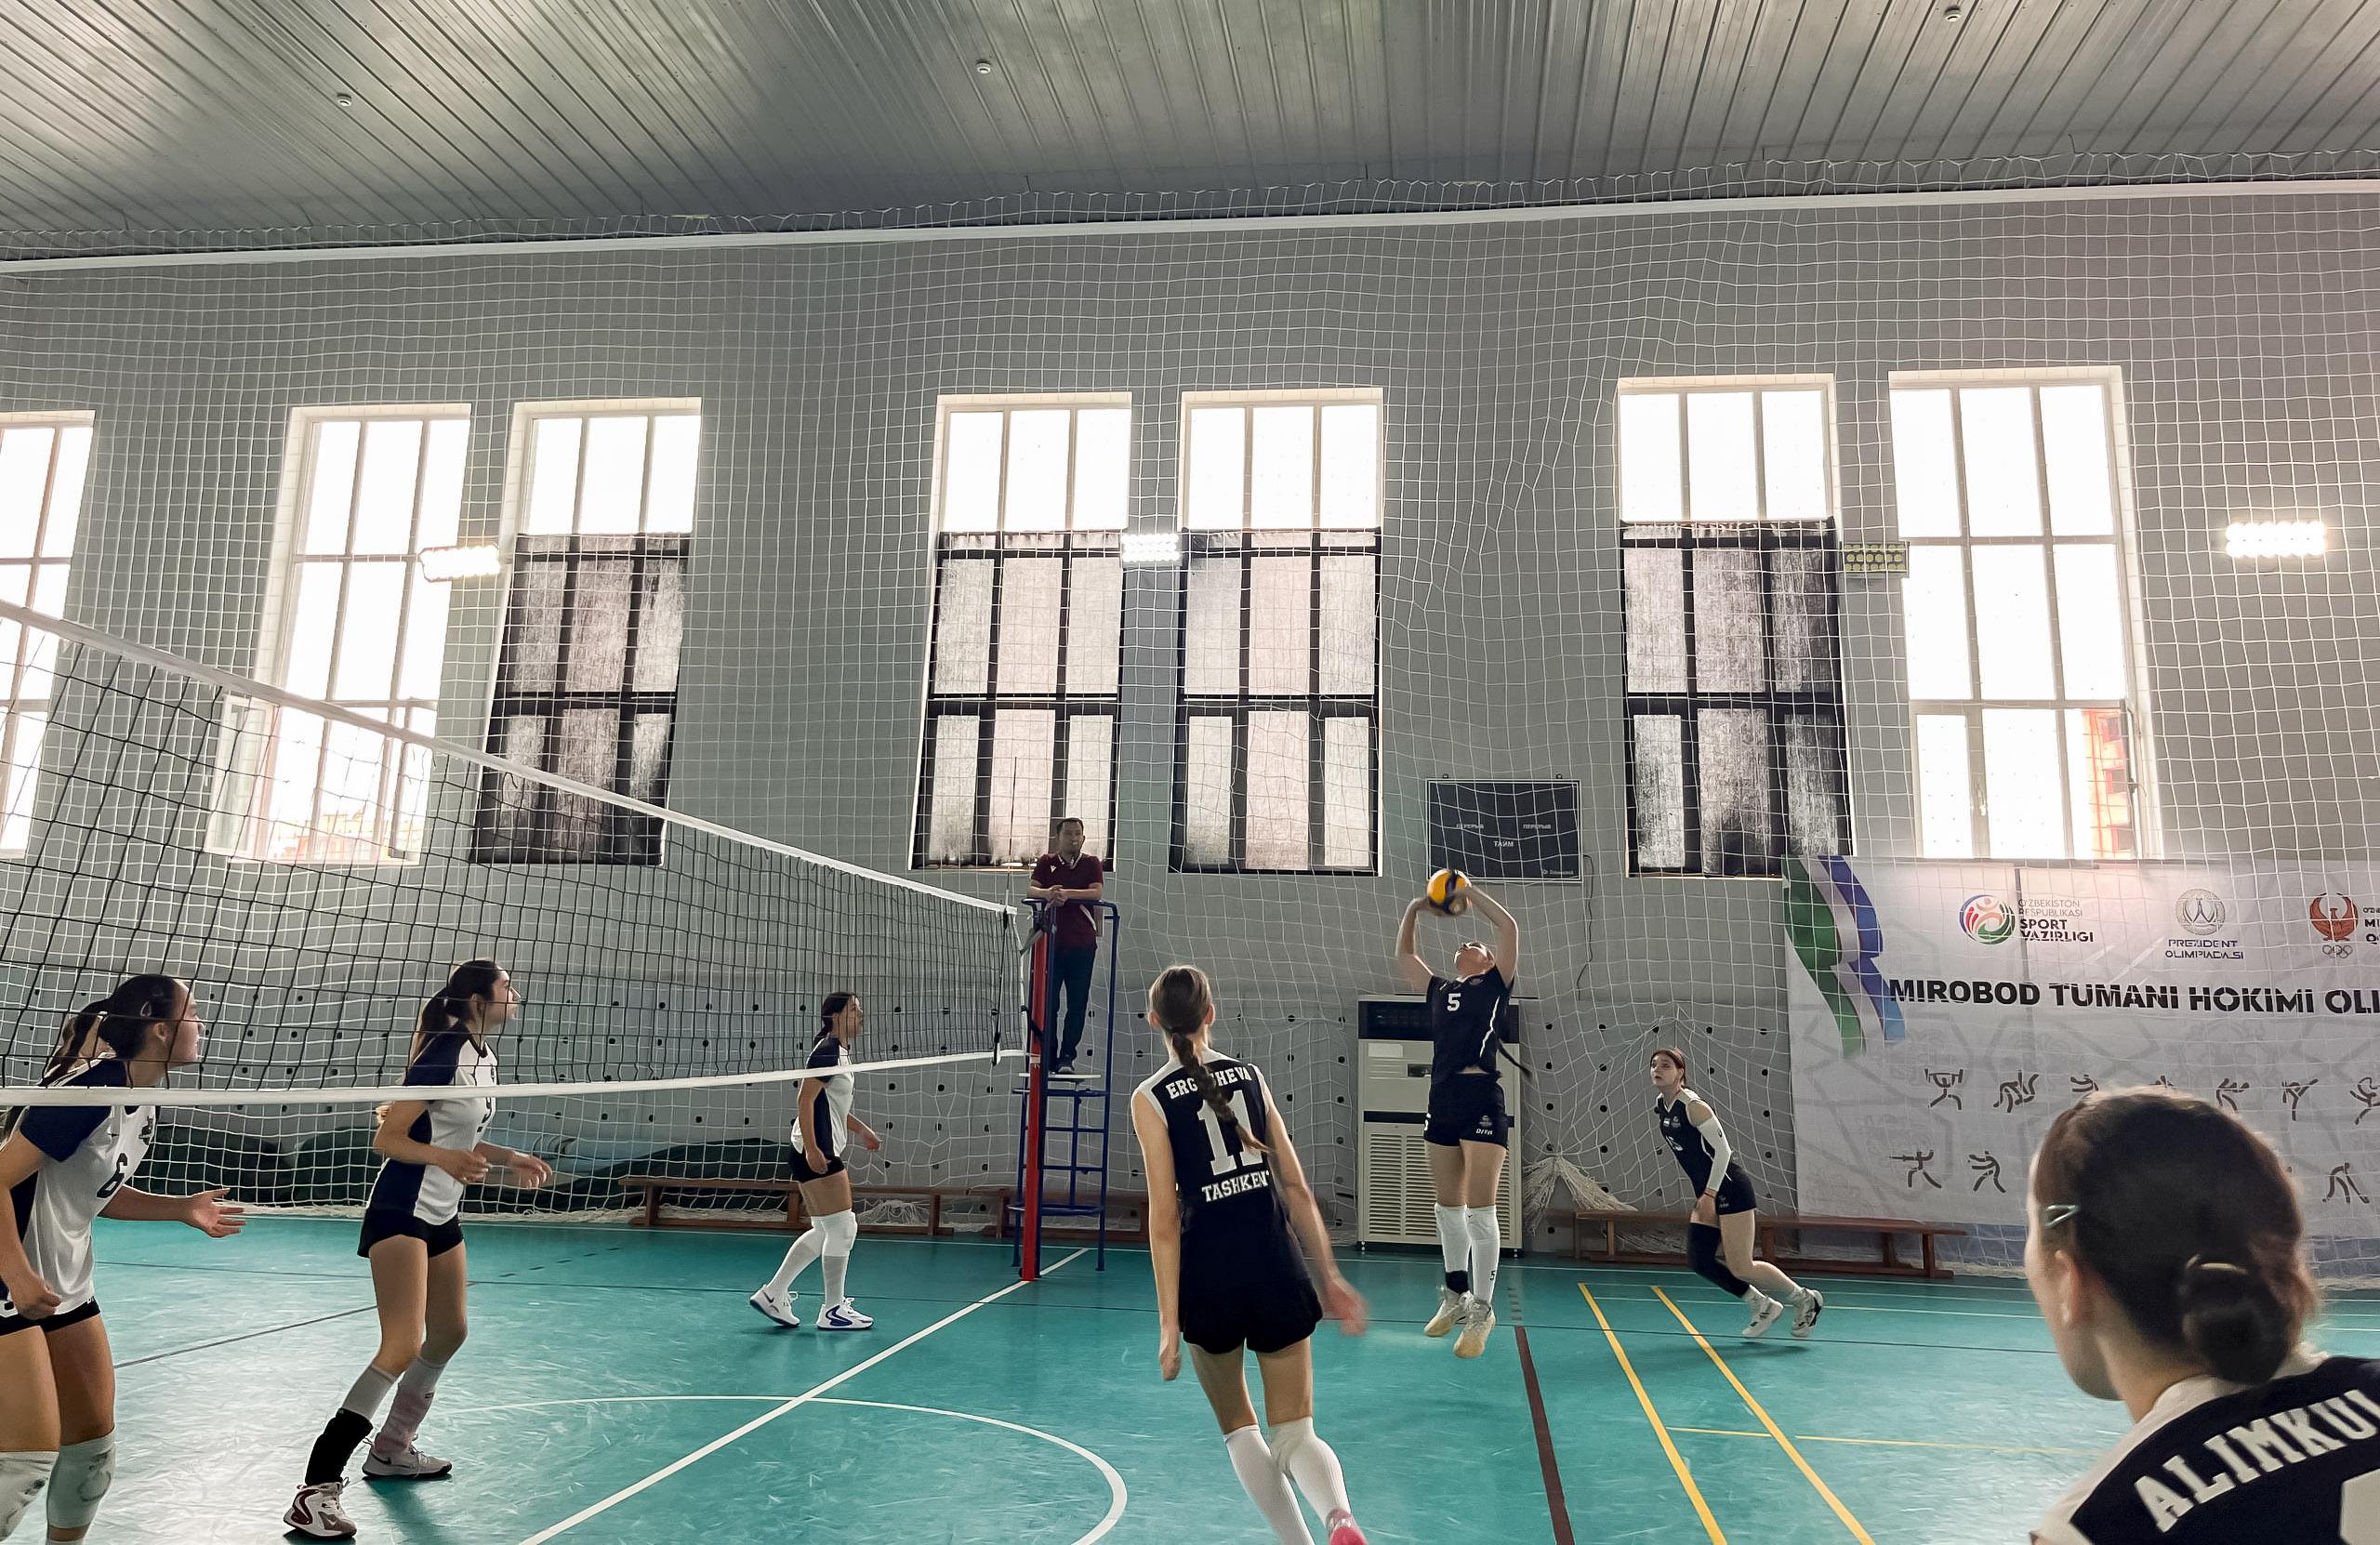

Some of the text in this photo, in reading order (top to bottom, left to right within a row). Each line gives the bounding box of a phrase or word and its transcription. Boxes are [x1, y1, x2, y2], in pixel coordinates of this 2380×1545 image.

[2020, 918, 2067, 930] SPORT
[2020, 930, 2094, 942] VAZIRLIGI
[2165, 950, 2244, 959] OLIMPIADASI
[2168, 939, 2238, 948] PREZIDENT
[1447, 993, 1461, 1011] 5
[1889, 979, 2041, 1006] MIROBOD
[2049, 982, 2179, 1010] TUMANI
[2188, 985, 2314, 1013] HOKIMI
[1165, 1066, 1252, 1100] ERGHEVA
[1197, 1089, 1263, 1176] 11
[96, 1153, 128, 1198] 6
[1201, 1169, 1270, 1203] TASHKEN
